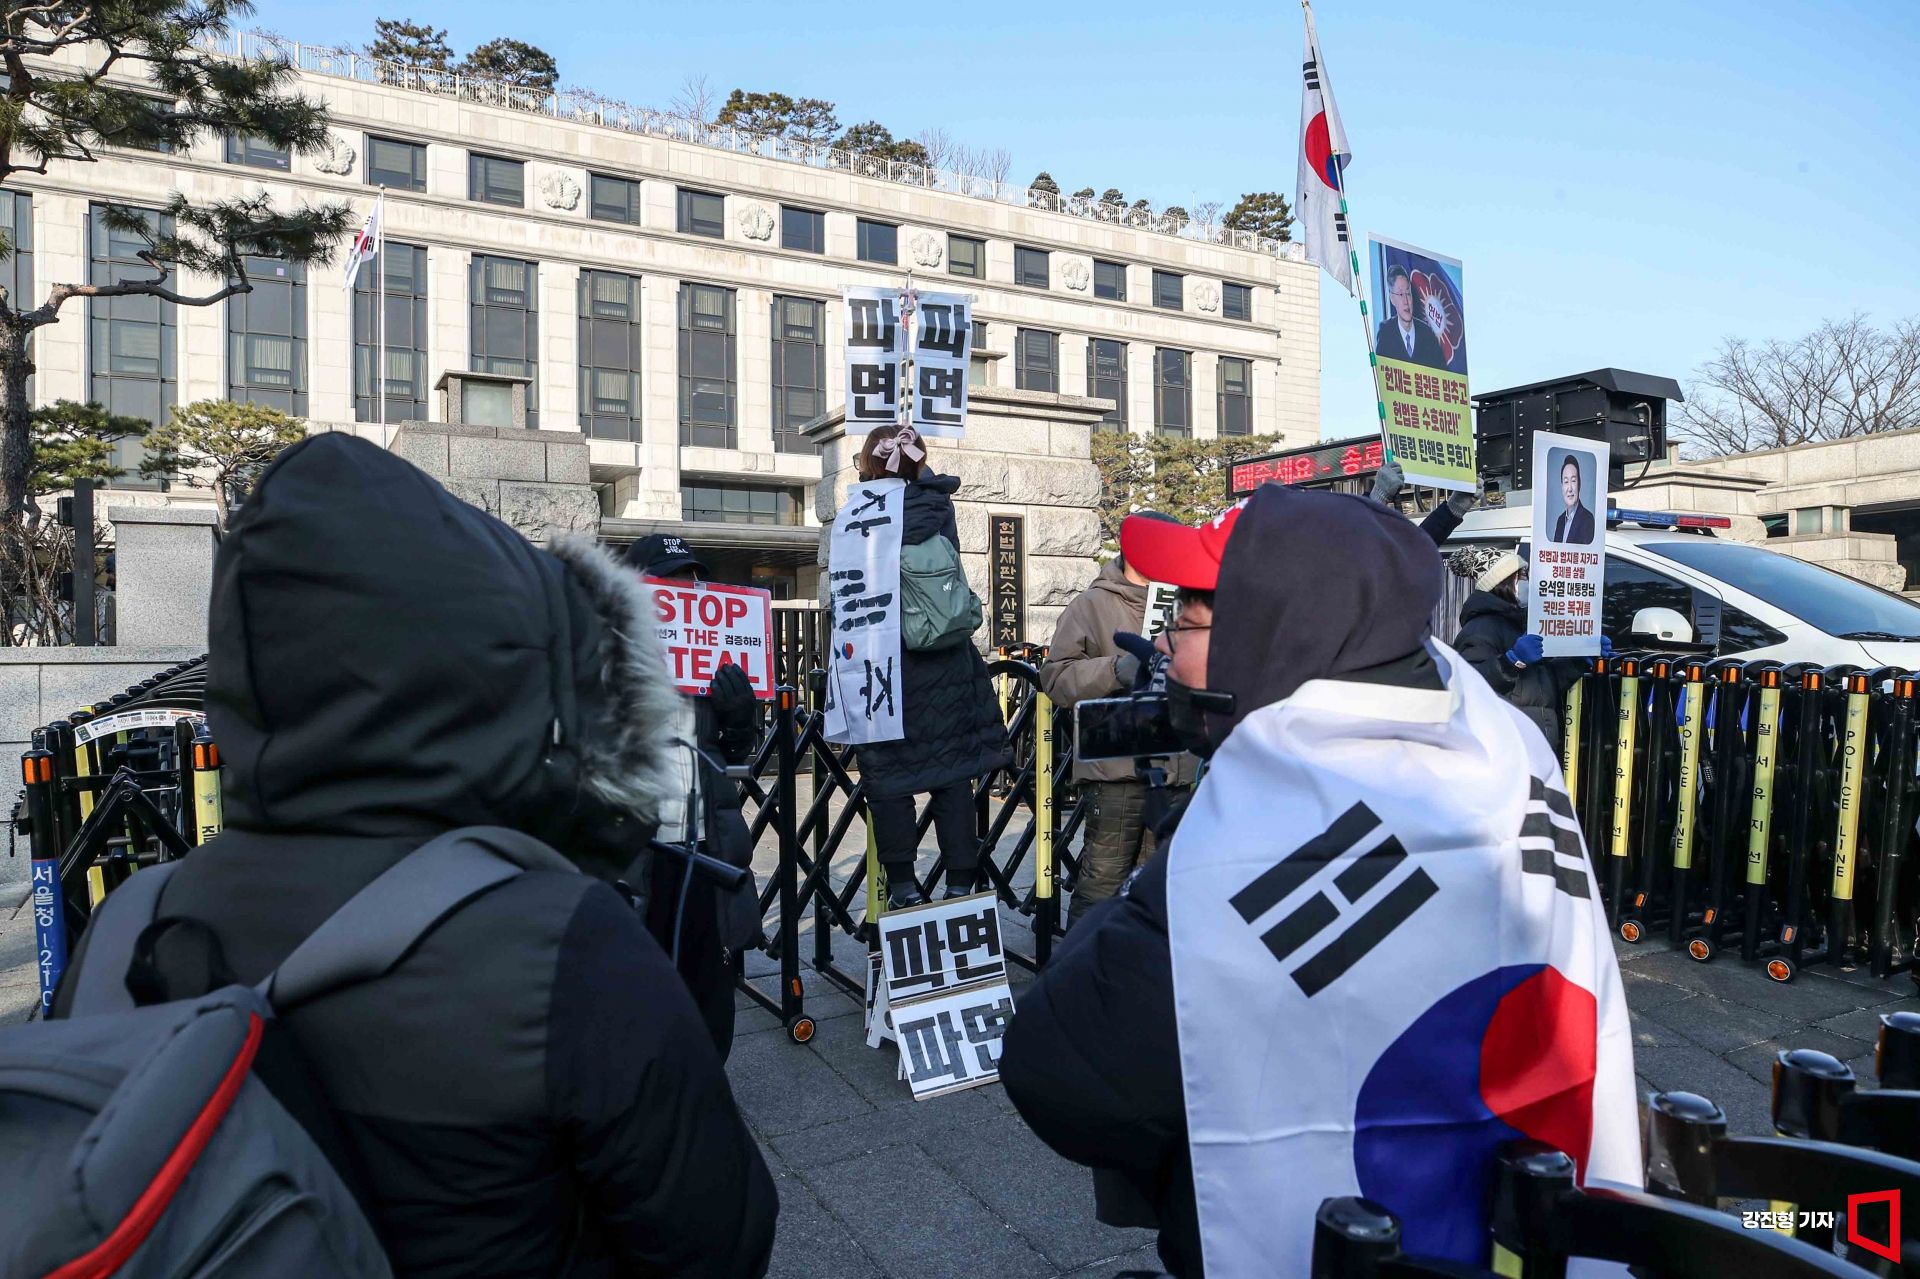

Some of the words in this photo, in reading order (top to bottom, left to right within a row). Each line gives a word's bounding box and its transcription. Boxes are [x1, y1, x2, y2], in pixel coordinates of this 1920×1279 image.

[848, 299, 899, 418] 파면
[919, 304, 970, 422] 파면
[1415, 373, 1440, 400] 월권을
[1442, 379, 1468, 405] 멈추고
[1393, 400, 1420, 429] 헌법을
[1389, 433, 1417, 460] 대통령
[1418, 438, 1445, 465] 탄핵은
[1447, 443, 1472, 469] 무효다
[663, 538, 681, 546] STOP
[1538, 550, 1558, 563] 헌법과
[1560, 552, 1578, 564] 법치를
[1580, 552, 1598, 565] 지키고
[999, 521, 1017, 641] 헌법재판소사무처
[1539, 580, 1565, 597] 윤석열
[1552, 566, 1571, 578] 경제를
[1573, 567, 1585, 579] 살릴
[652, 589, 747, 628] STOP
[1538, 619, 1594, 636] 기다렸습니다!
[1543, 601, 1565, 615] 국민은
[1567, 600, 1591, 616] 복귀를
[684, 628, 718, 646] THE
[725, 635, 761, 647] 검증하라
[668, 646, 759, 684] TEAL
[1680, 715, 1692, 787] POLICE
[1841, 730, 1856, 810] POLICE
[1613, 708, 1630, 837] 질서유지선
[1749, 723, 1771, 864] 질서유지선
[1677, 801, 1685, 848] LINE
[1836, 826, 1846, 877] LINE
[33, 866, 54, 927] 서울청
[885, 908, 1003, 990] 파면
[899, 998, 1015, 1084] 파면
